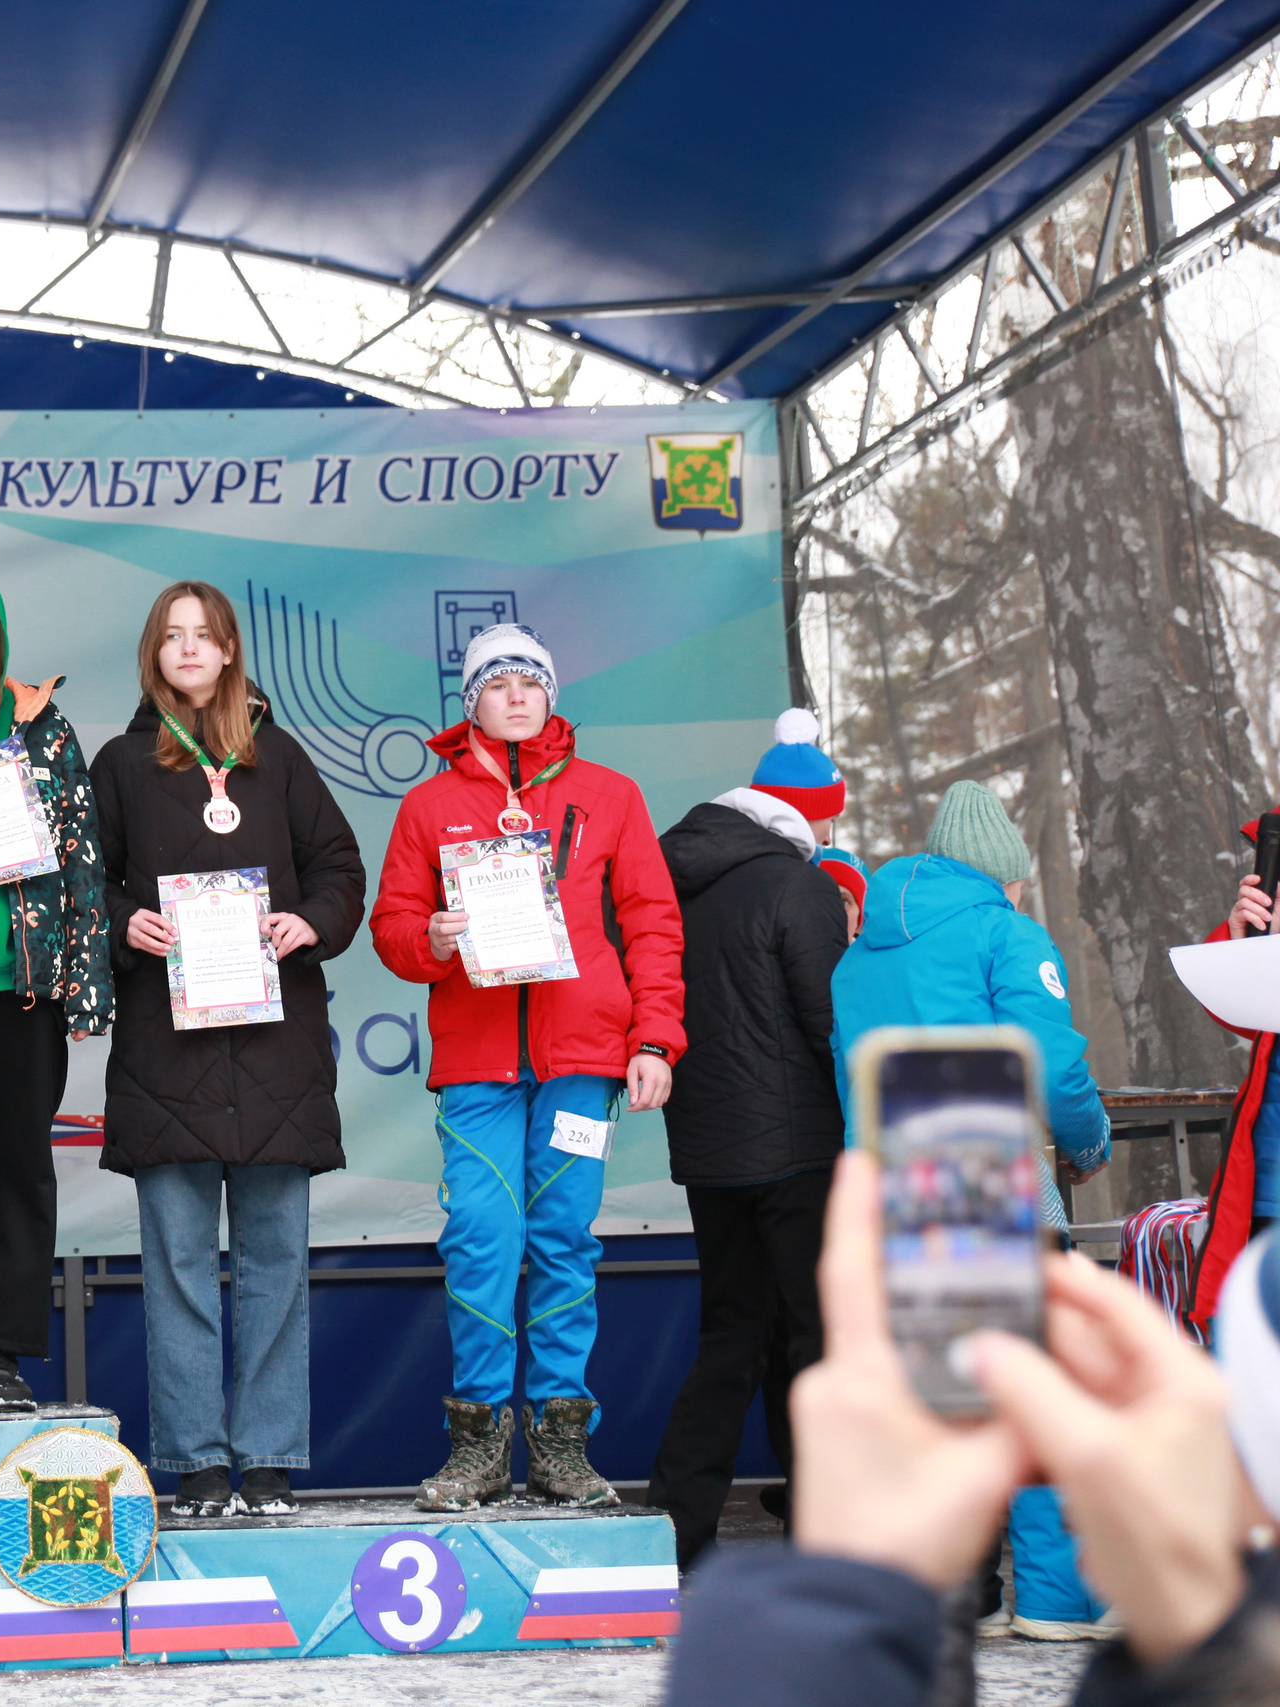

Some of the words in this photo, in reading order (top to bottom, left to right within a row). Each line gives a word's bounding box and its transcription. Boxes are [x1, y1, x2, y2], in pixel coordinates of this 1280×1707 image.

[310, 457, 351, 505] И
[379, 452, 620, 503] СПОРТУ
[446, 824, 473, 832] Columbia
[468, 867, 531, 887] ГРАМОТА
[186, 905, 248, 920] ГРАМОТА
[567, 1129, 591, 1145] 226
[378, 1539, 442, 1643] 3
